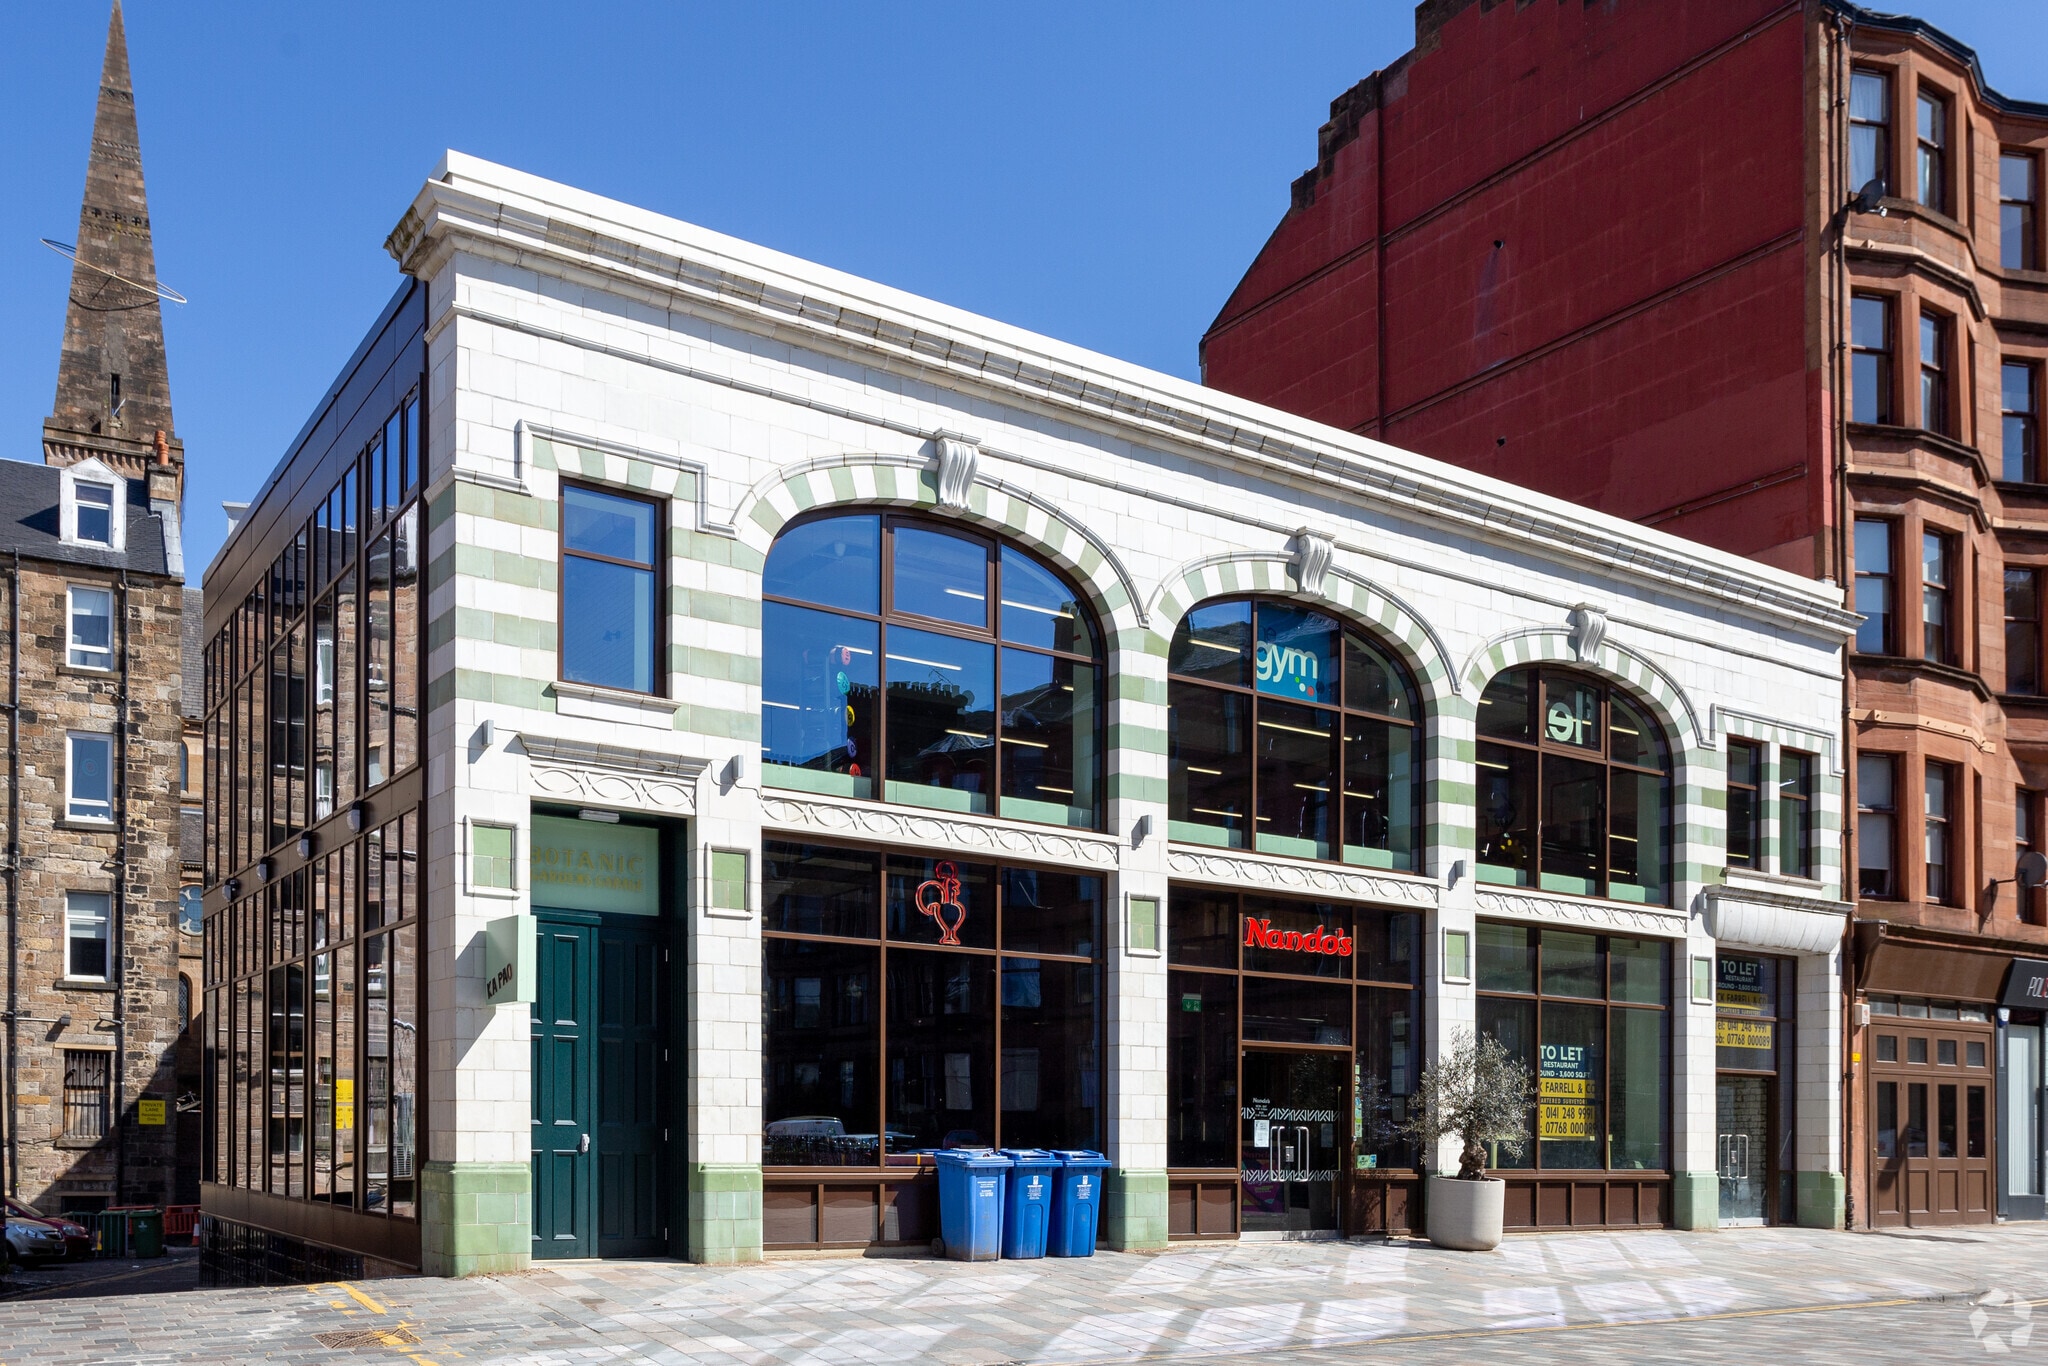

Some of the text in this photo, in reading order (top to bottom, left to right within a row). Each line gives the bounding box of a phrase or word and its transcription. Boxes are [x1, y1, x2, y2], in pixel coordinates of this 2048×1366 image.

[1257, 640, 1318, 683] gym
[530, 845, 643, 875] BOTANIC
[1243, 916, 1352, 957] Nando's
[1721, 960, 1758, 976] TO LET
[486, 963, 513, 1000] KA PAO
[1725, 974, 1755, 983] RESTAURANT
[1741, 1021, 1752, 1032] 248
[1727, 1033, 1745, 1045] 07768
[1748, 1034, 1770, 1047] 000089
[1540, 1045, 1583, 1062] TO LET
[1543, 1061, 1579, 1069] RESTAURANT
[1559, 1070, 1575, 1078] 3,600
[1545, 1082, 1575, 1093] FARRELL
[1577, 1083, 1583, 1094] &
[1546, 1106, 1559, 1119] 0141
[1562, 1107, 1575, 1120] 248
[1578, 1108, 1593, 1120] 9991
[1545, 1121, 1567, 1134] 07768
[1570, 1122, 1596, 1134] 000089
